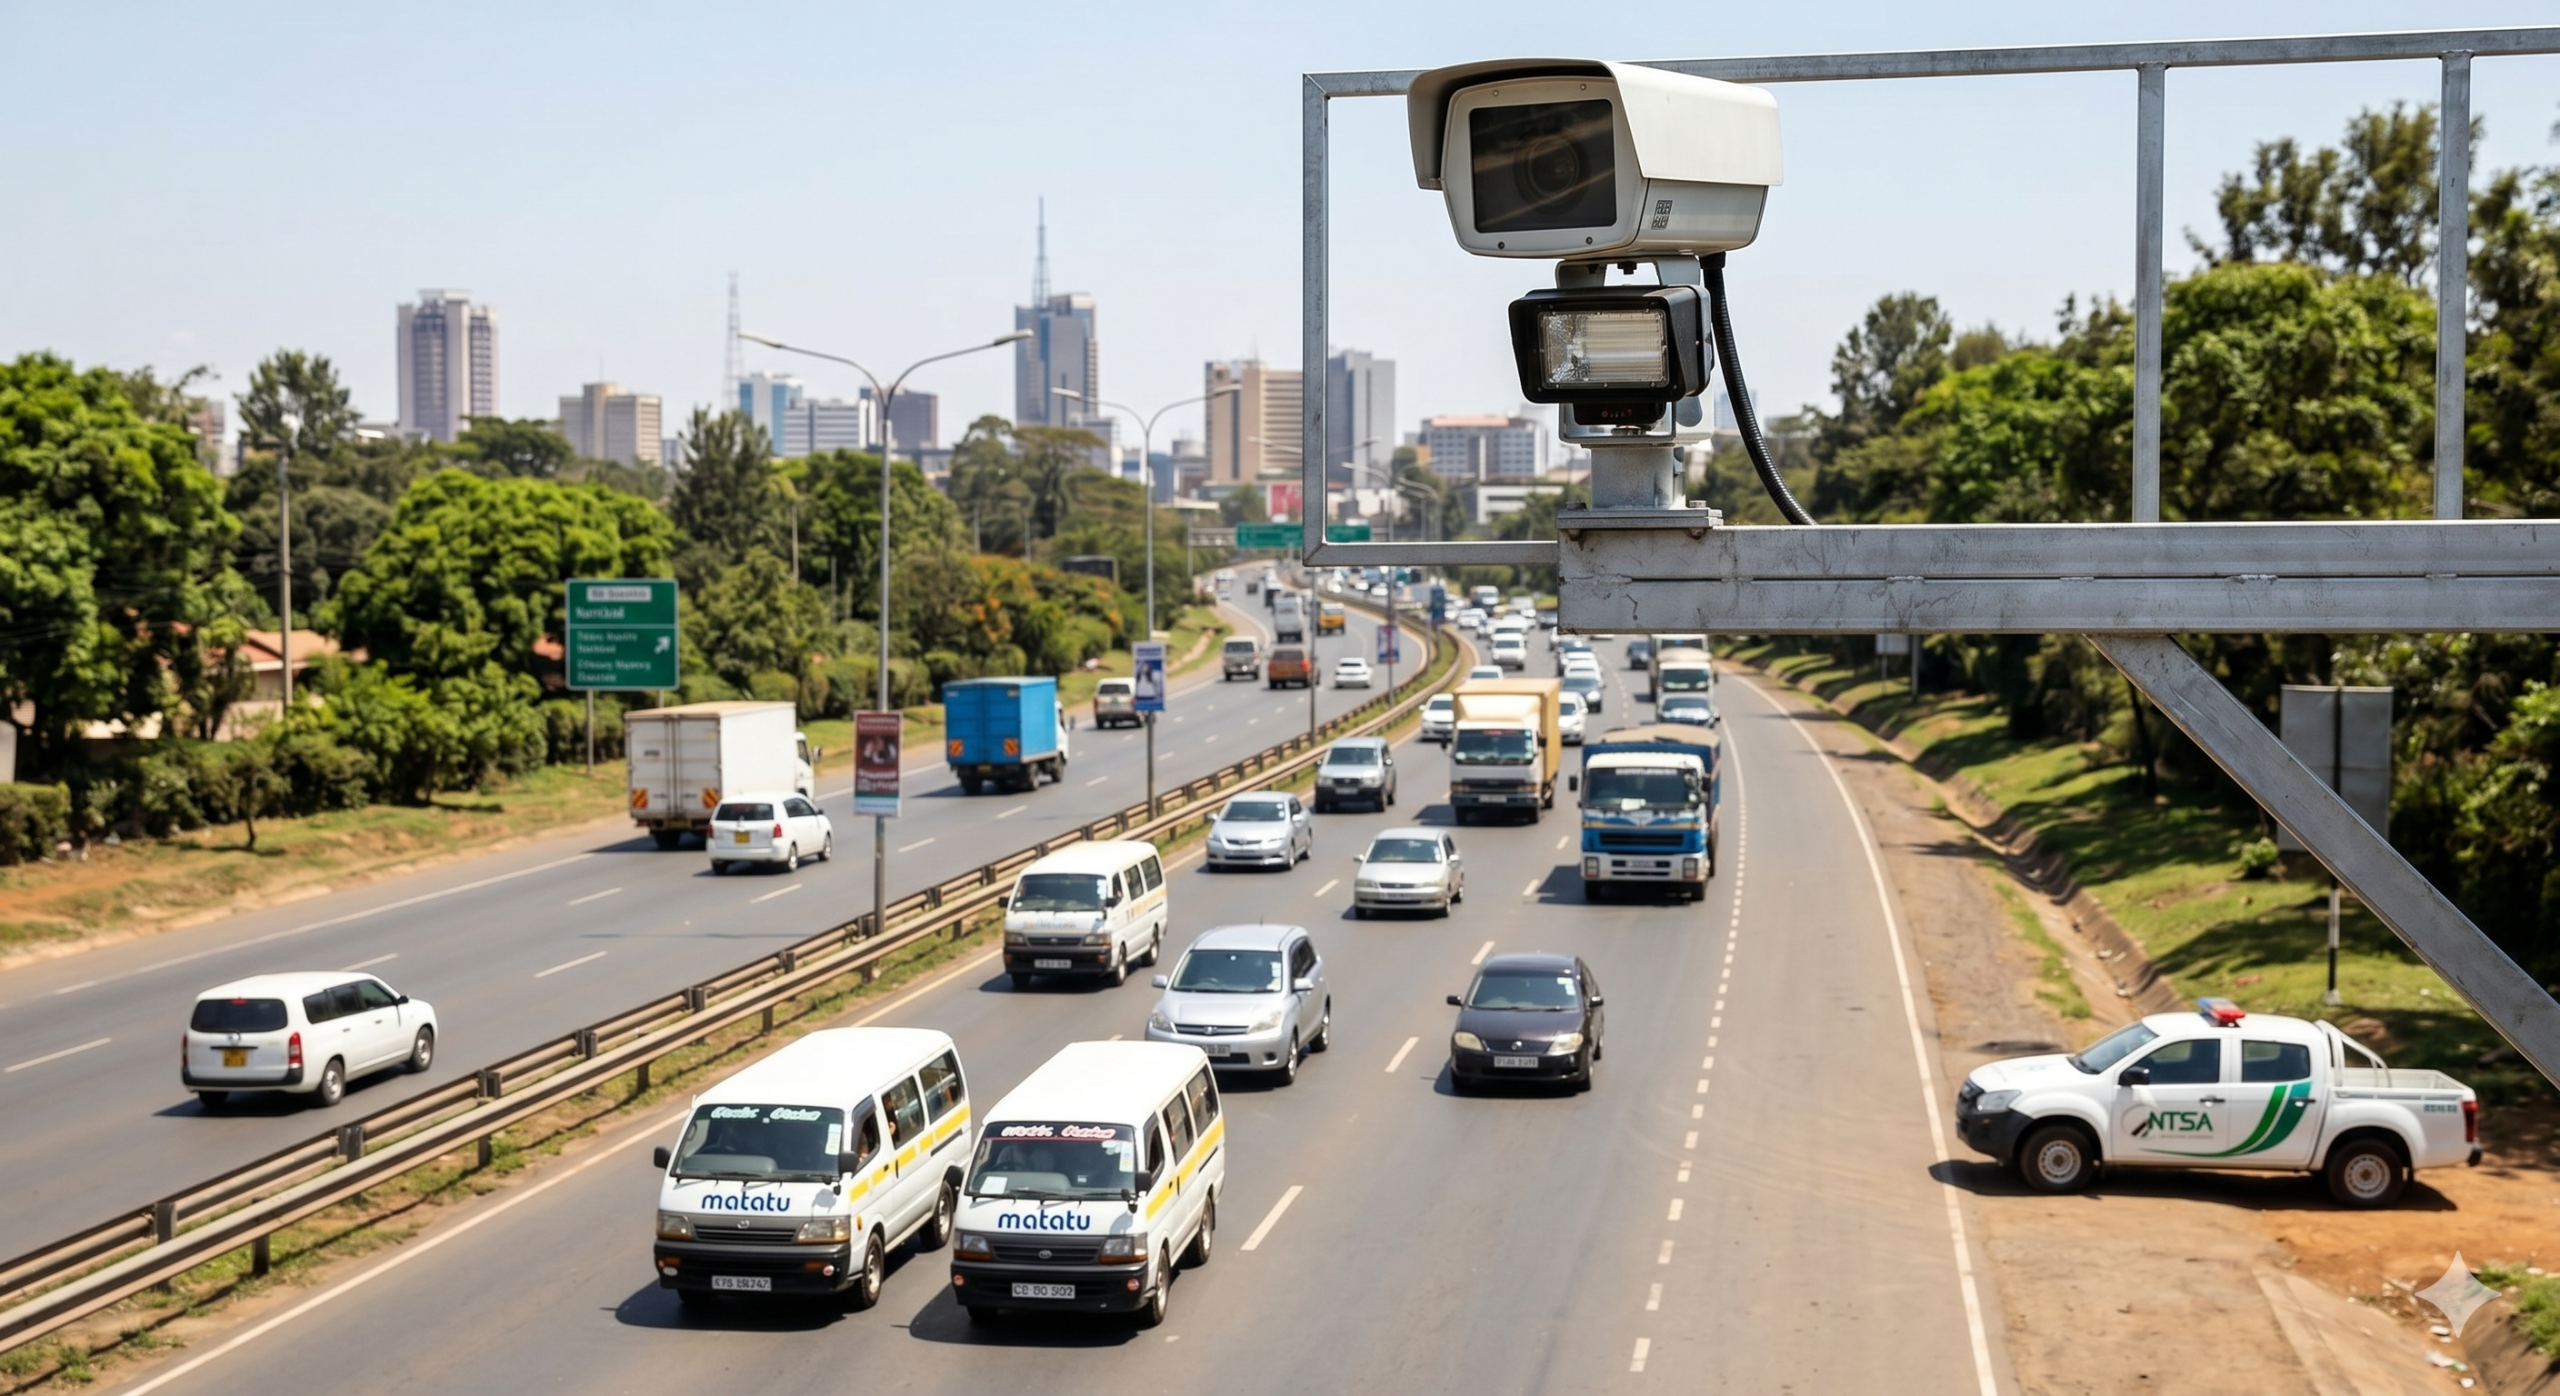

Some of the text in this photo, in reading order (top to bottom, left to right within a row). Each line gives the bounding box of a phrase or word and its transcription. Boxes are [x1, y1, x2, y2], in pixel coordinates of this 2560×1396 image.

[2149, 1111, 2213, 1131] NTSA
[702, 1191, 790, 1212] matatu
[998, 1209, 1090, 1230] matatu
